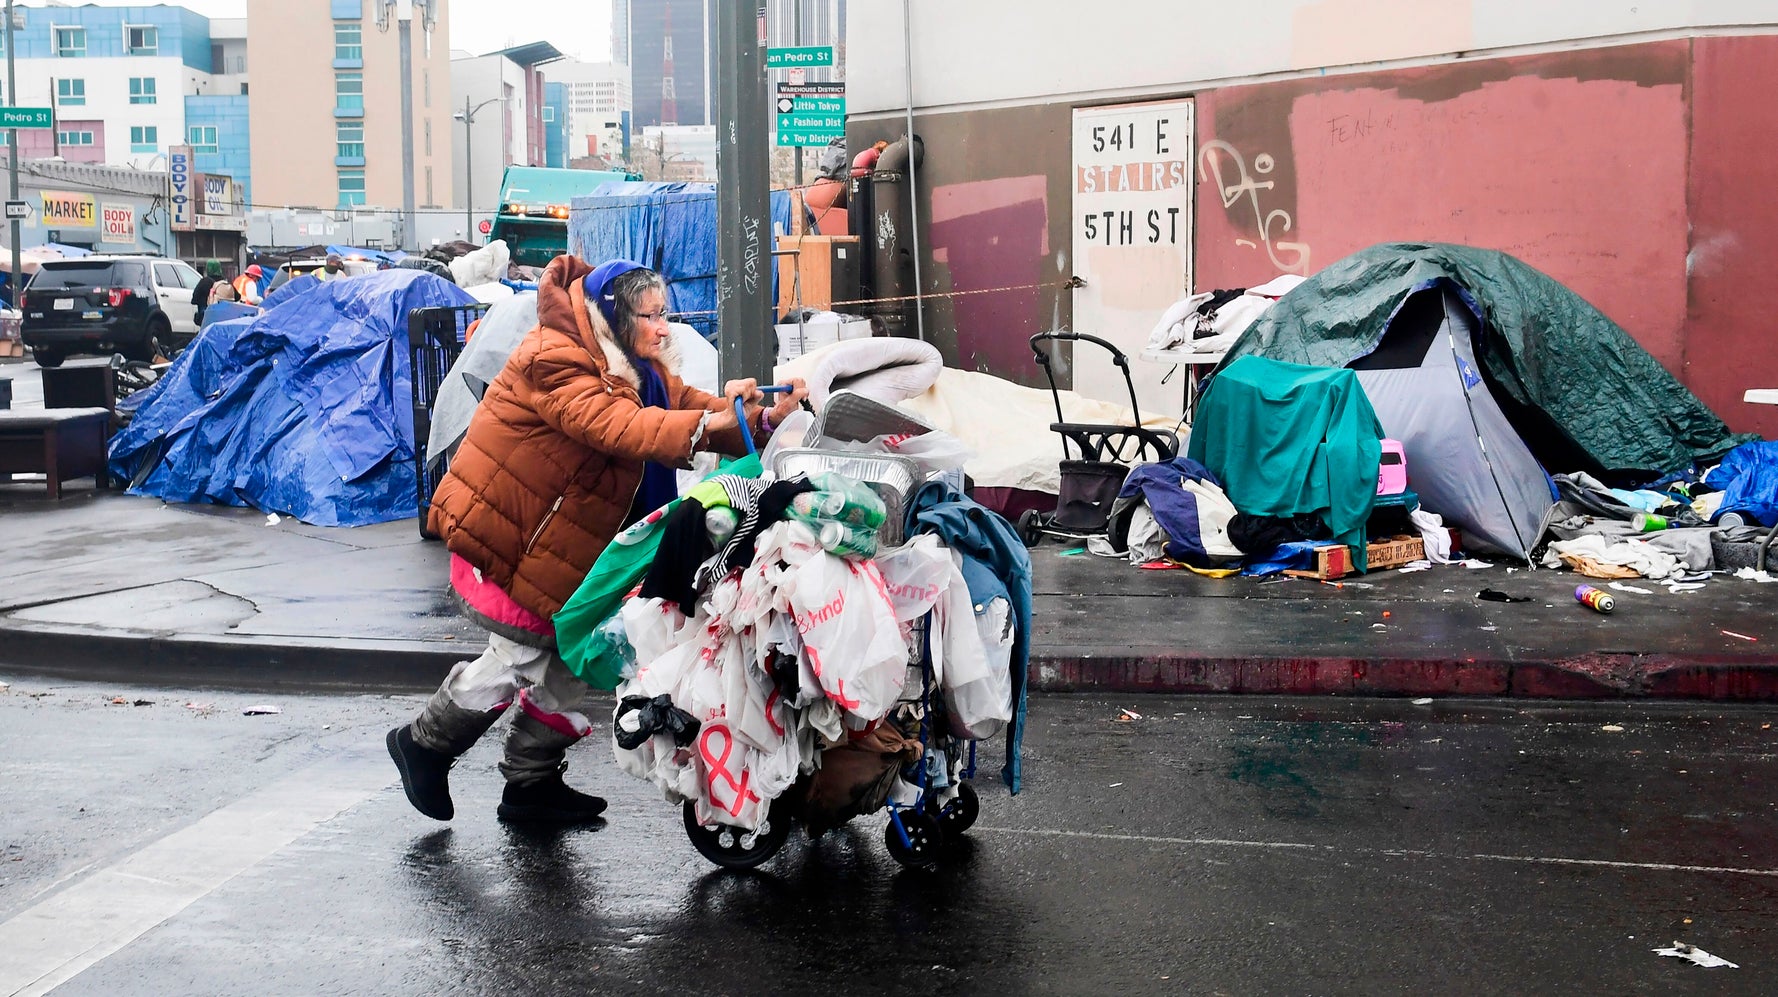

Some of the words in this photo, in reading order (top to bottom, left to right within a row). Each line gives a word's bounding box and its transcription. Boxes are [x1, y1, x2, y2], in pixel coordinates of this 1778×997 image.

[785, 53, 813, 62] Pedro
[817, 52, 829, 60] St
[794, 102, 815, 110] Little
[818, 102, 840, 112] Tokyo
[4, 112, 33, 122] Pedro
[36, 112, 47, 122] St
[794, 118, 823, 127] Fashion
[826, 118, 841, 127] Dist
[794, 134, 807, 144] Toy
[809, 134, 838, 143] Distri
[1093, 123, 1134, 153] 541
[1156, 119, 1169, 154] E
[172, 154, 187, 193] BODY
[1083, 161, 1184, 194] STAIRS
[44, 200, 93, 219] MARKET
[172, 194, 187, 223] OIL
[104, 210, 132, 222] BODY
[110, 222, 127, 234] OIL
[1084, 210, 1133, 246] 5TH
[1147, 207, 1180, 244] ST
